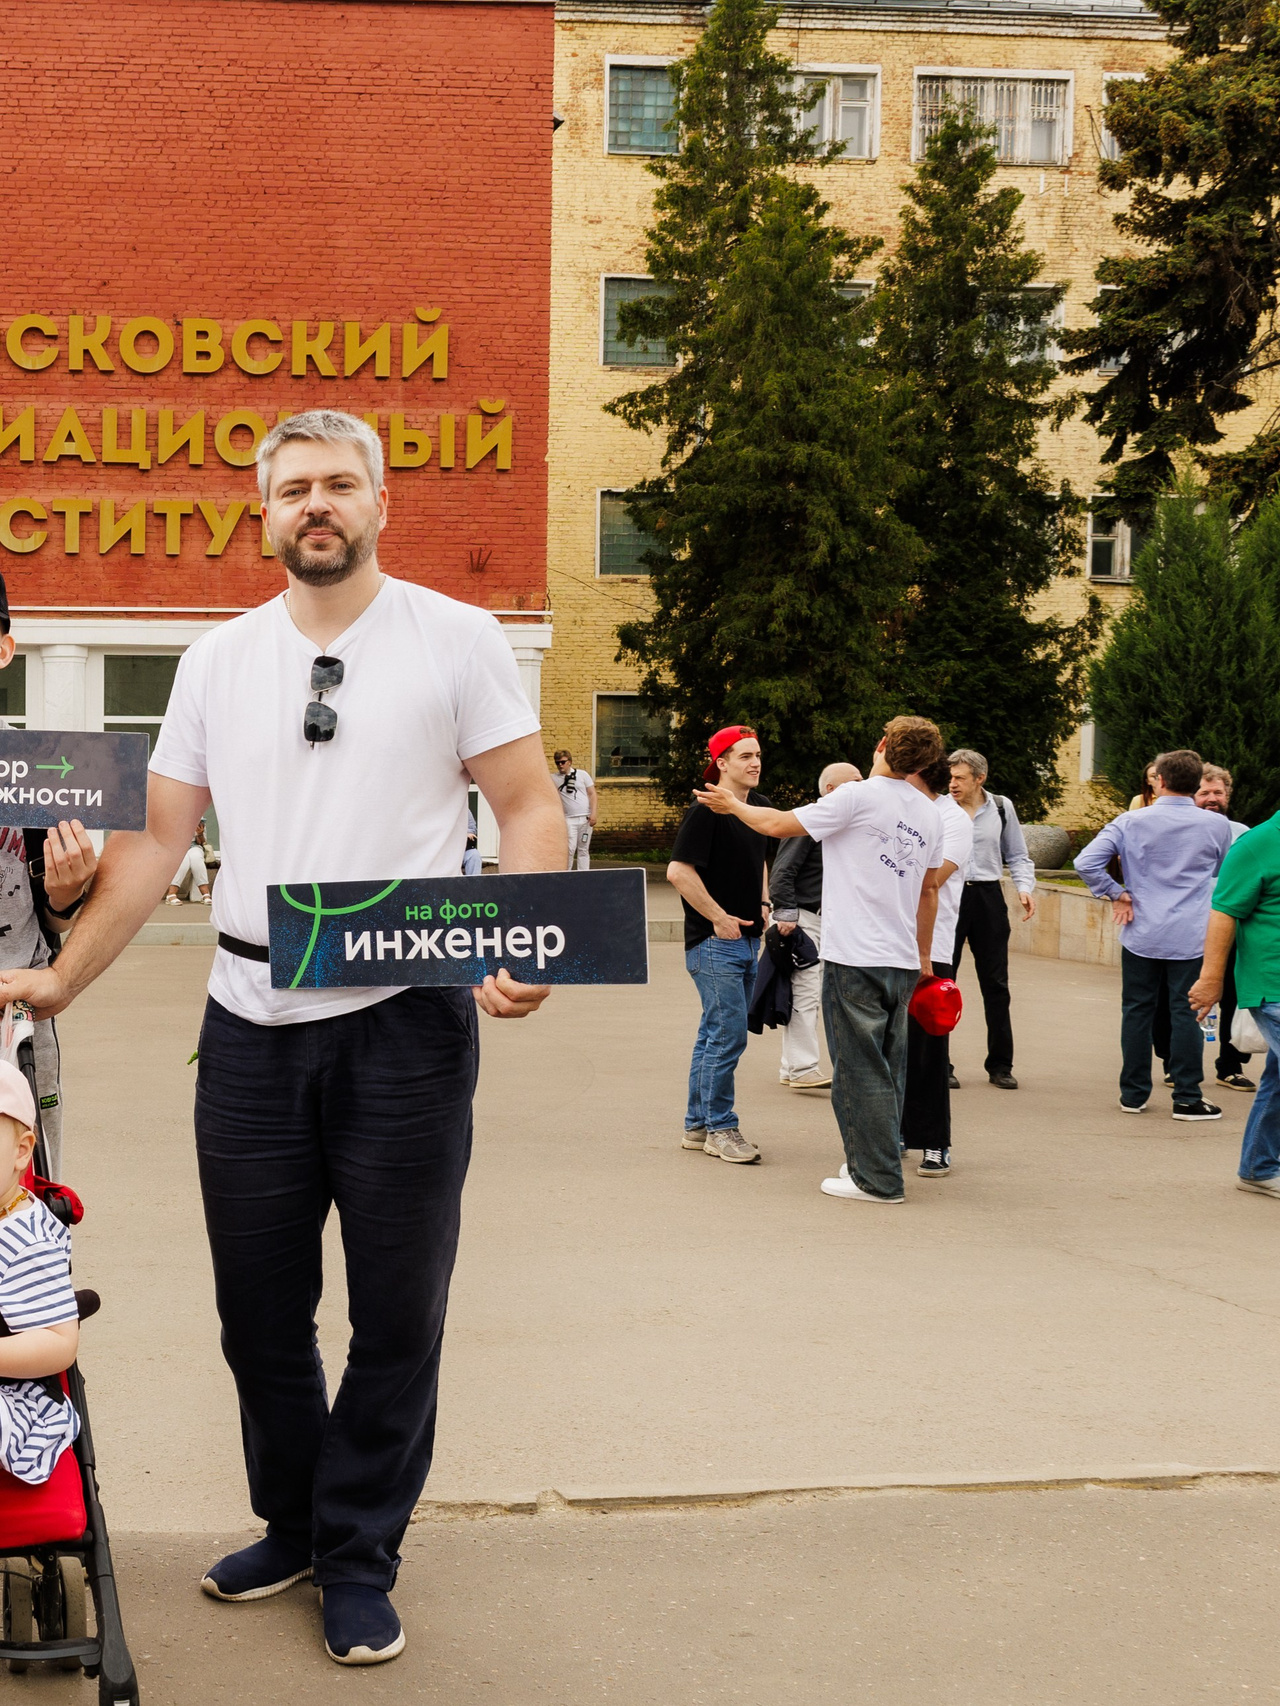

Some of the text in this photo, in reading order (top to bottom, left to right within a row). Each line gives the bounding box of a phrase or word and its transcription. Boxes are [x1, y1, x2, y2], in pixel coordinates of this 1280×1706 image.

[405, 898, 499, 924] на фото
[344, 924, 566, 970] инженер
